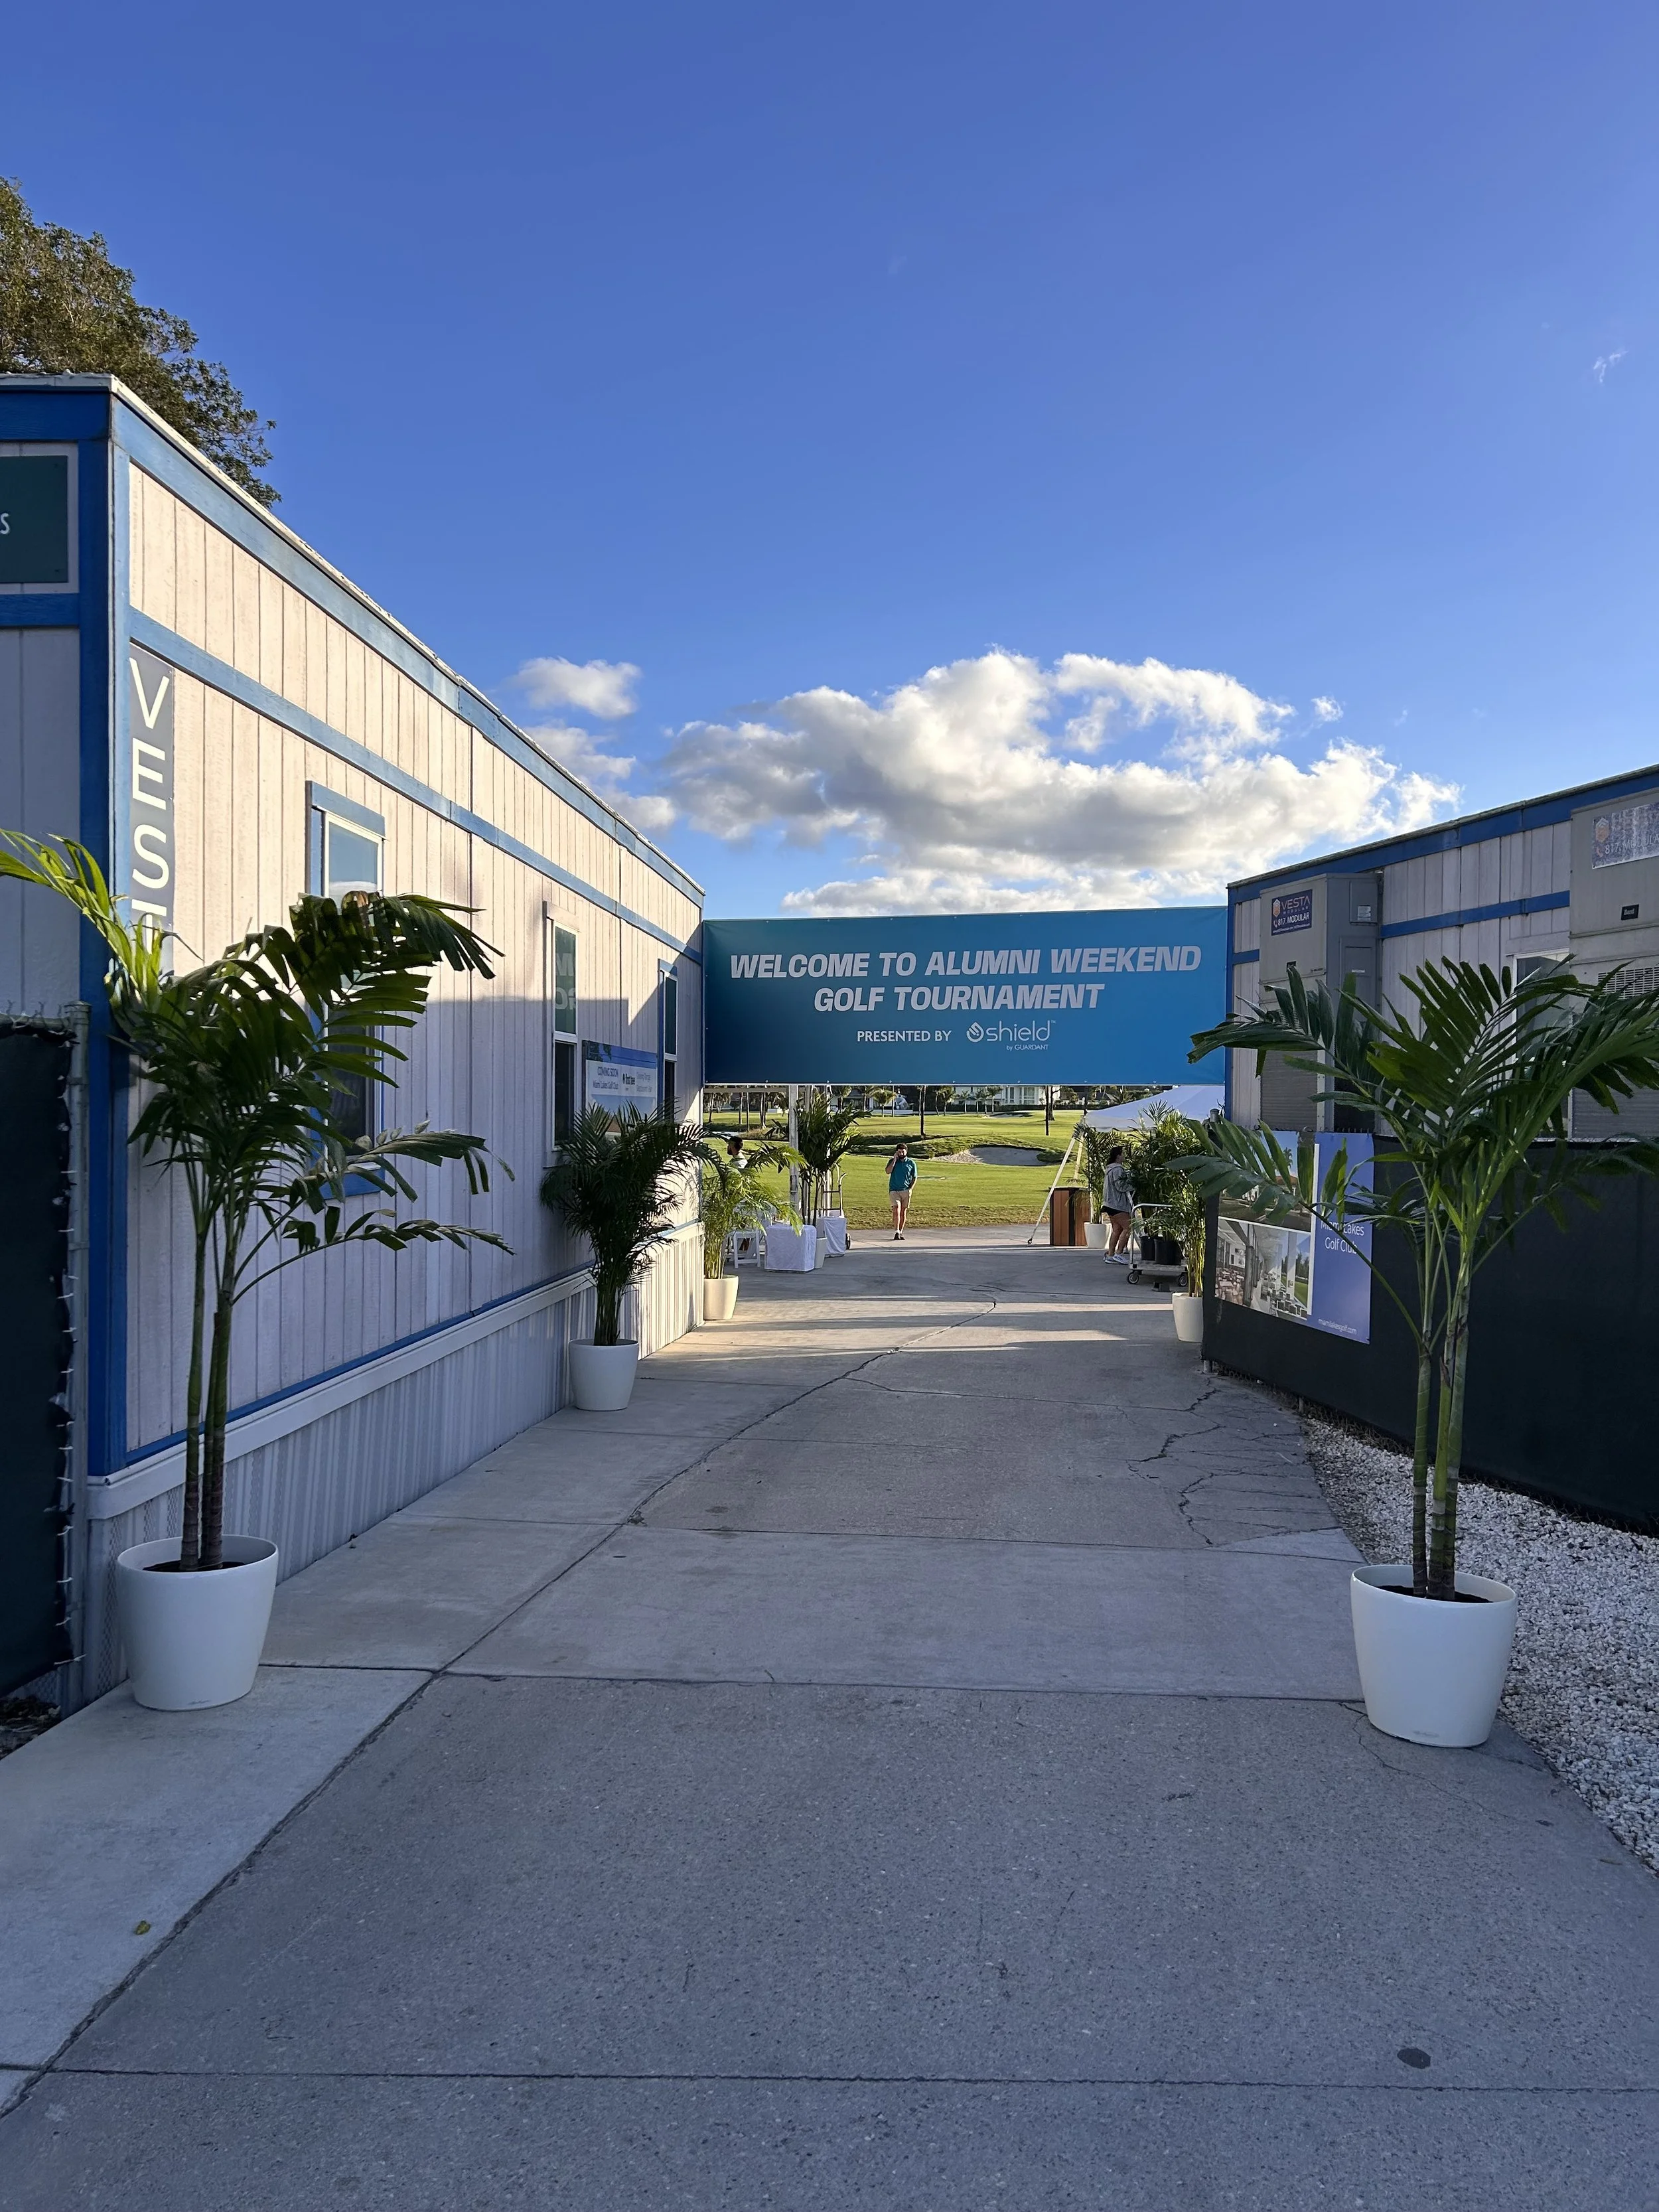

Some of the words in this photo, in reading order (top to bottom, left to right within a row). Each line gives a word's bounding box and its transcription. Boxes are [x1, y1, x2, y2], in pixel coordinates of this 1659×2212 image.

[1281, 895, 1311, 911] VESTA
[1287, 912, 1310, 923] MODULAR
[731, 953, 870, 979] WELCOME
[879, 952, 917, 977] TO
[924, 949, 1041, 976] ALUMNI
[1051, 945, 1202, 974] WEEKEND
[814, 987, 885, 1012] GOLF
[894, 984, 1105, 1011] TOURNAMENT
[857, 1030, 931, 1042] PRESENTED
[934, 1030, 952, 1041] BY
[985, 1020, 1050, 1041] shield
[1343, 1222, 1364, 1236] Lakes
[1325, 1236, 1340, 1251] Golf
